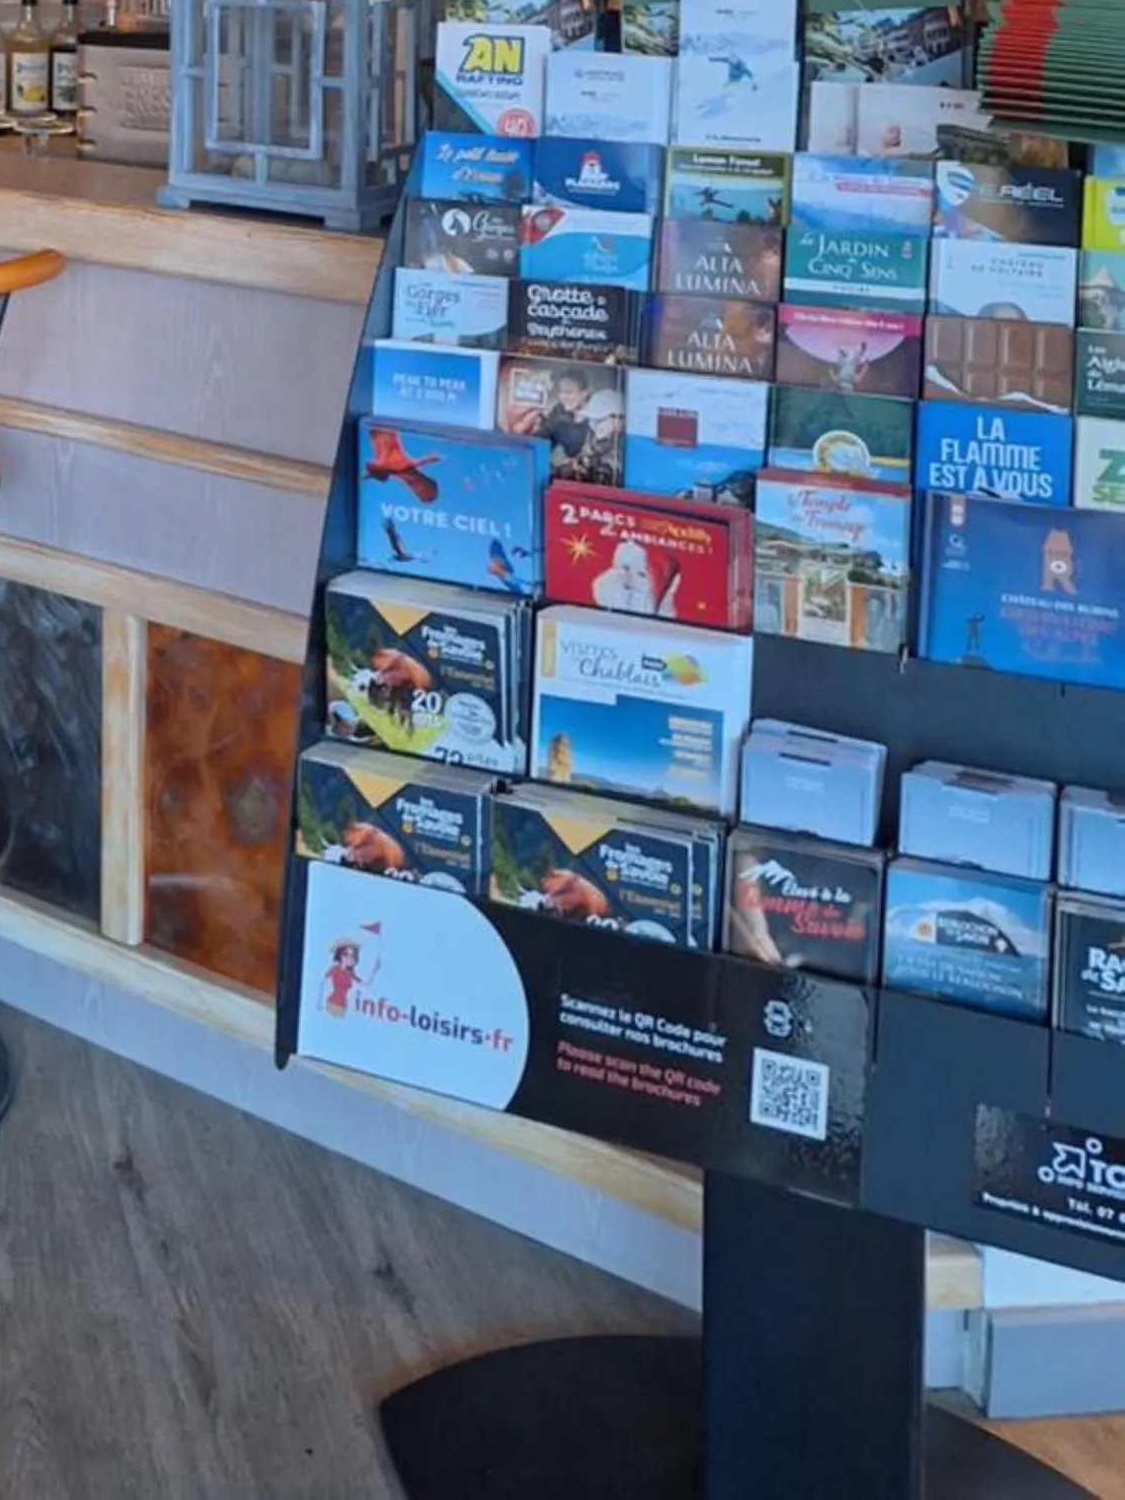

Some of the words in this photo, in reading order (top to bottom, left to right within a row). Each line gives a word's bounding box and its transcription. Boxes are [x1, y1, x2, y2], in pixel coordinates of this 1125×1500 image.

[456, 73, 524, 86] RAFTING
[816, 232, 890, 260] JARDIN
[695, 253, 745, 275] ALTA
[807, 257, 854, 279] CINQ
[859, 261, 899, 282] SENS
[527, 284, 593, 305] Grotte
[675, 271, 762, 296] LUMINA
[527, 302, 609, 323] cascade
[687, 331, 737, 351] ALTA
[666, 349, 754, 374] LUMINA
[976, 415, 1006, 442] LA
[940, 438, 1042, 472] FLAMME
[928, 462, 969, 489] EST
[992, 468, 1053, 499] VOUS
[380, 502, 449, 530] VOTRE
[451, 514, 501, 537] CIEL
[559, 503, 579, 525] 2
[578, 505, 636, 528] PARCS
[599, 521, 617, 537] 2
[619, 530, 706, 555] AMBIANCES
[578, 654, 662, 689] Chablais
[411, 689, 443, 714] 20
[598, 843, 673, 874] Fromages
[793, 912, 867, 942] Savoie
[1088, 946, 1125, 972] RA
[559, 992, 616, 1021] Scannez
[617, 1007, 633, 1024] le
[633, 1011, 655, 1031] QR
[656, 1017, 692, 1038] Code
[692, 1029, 727, 1049] pour
[558, 1011, 623, 1038] consulter
[624, 1029, 651, 1046] nos
[652, 1032, 724, 1064] brochures
[556, 1040, 604, 1065] Please
[604, 1052, 638, 1073] scan
[638, 1059, 663, 1079] the
[663, 1066, 685, 1085] QR
[685, 1075, 722, 1097] code
[556, 1057, 572, 1073] to
[572, 1061, 605, 1080] read
[605, 1069, 630, 1088] the
[631, 1072, 702, 1107] brochures
